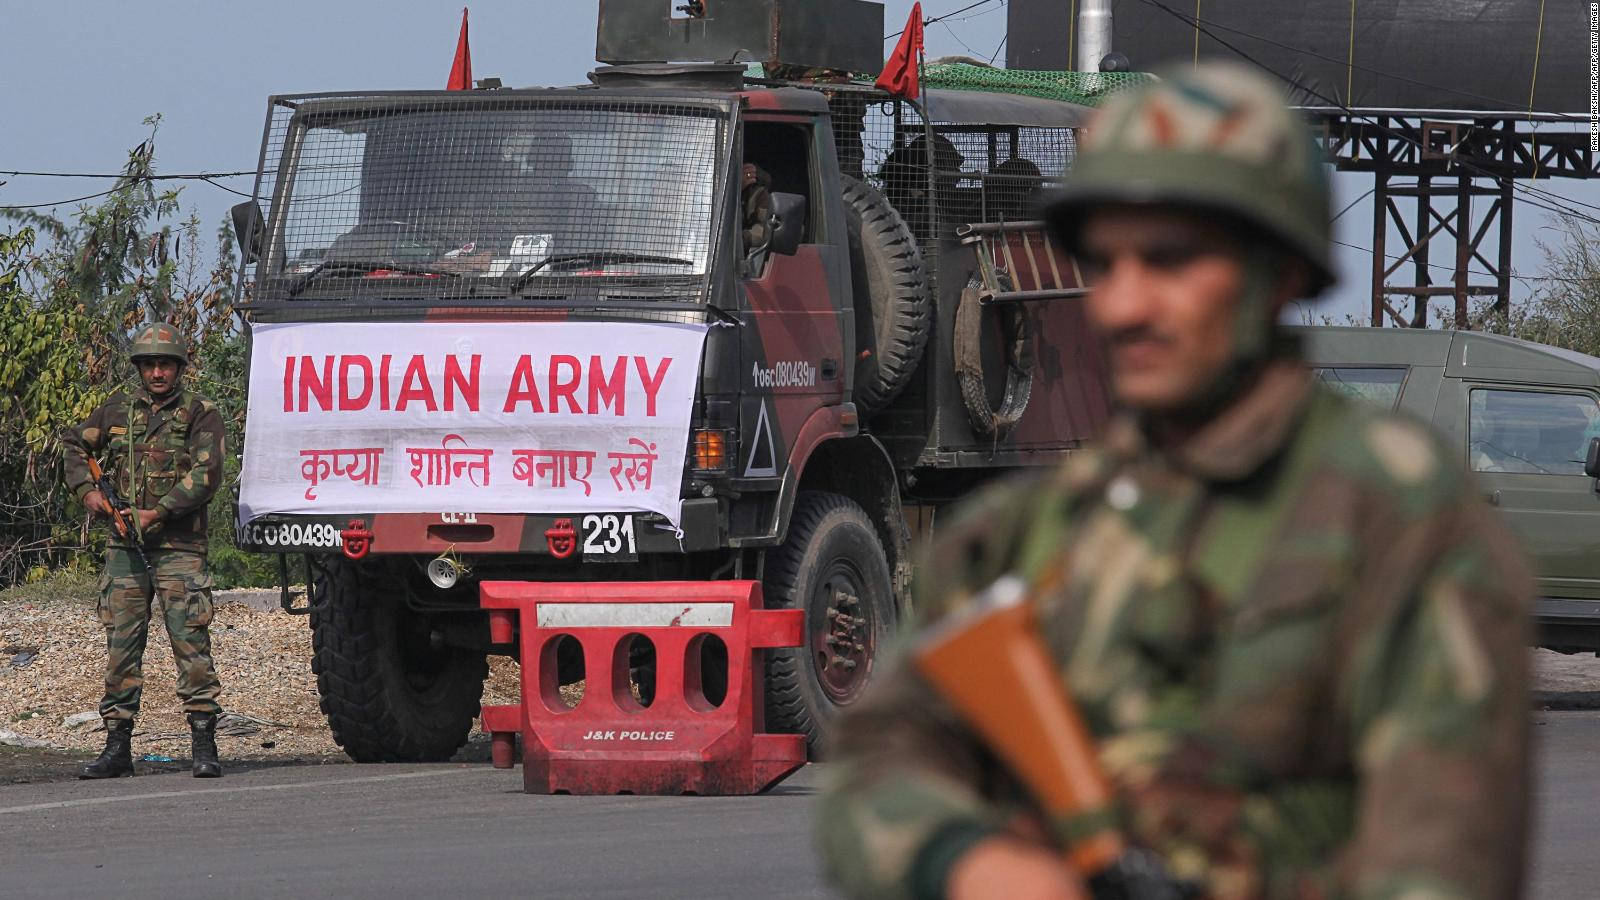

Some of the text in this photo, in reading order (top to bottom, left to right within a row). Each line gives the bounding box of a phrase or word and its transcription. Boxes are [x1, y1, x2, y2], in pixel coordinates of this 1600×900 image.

[283, 354, 482, 413] INDIAN
[503, 354, 673, 417] ARMY
[300, 434, 658, 501] कृप्या शान्ति बनाए रखें
[582, 514, 637, 554] 231
[583, 730, 676, 741] J&K POLICE
